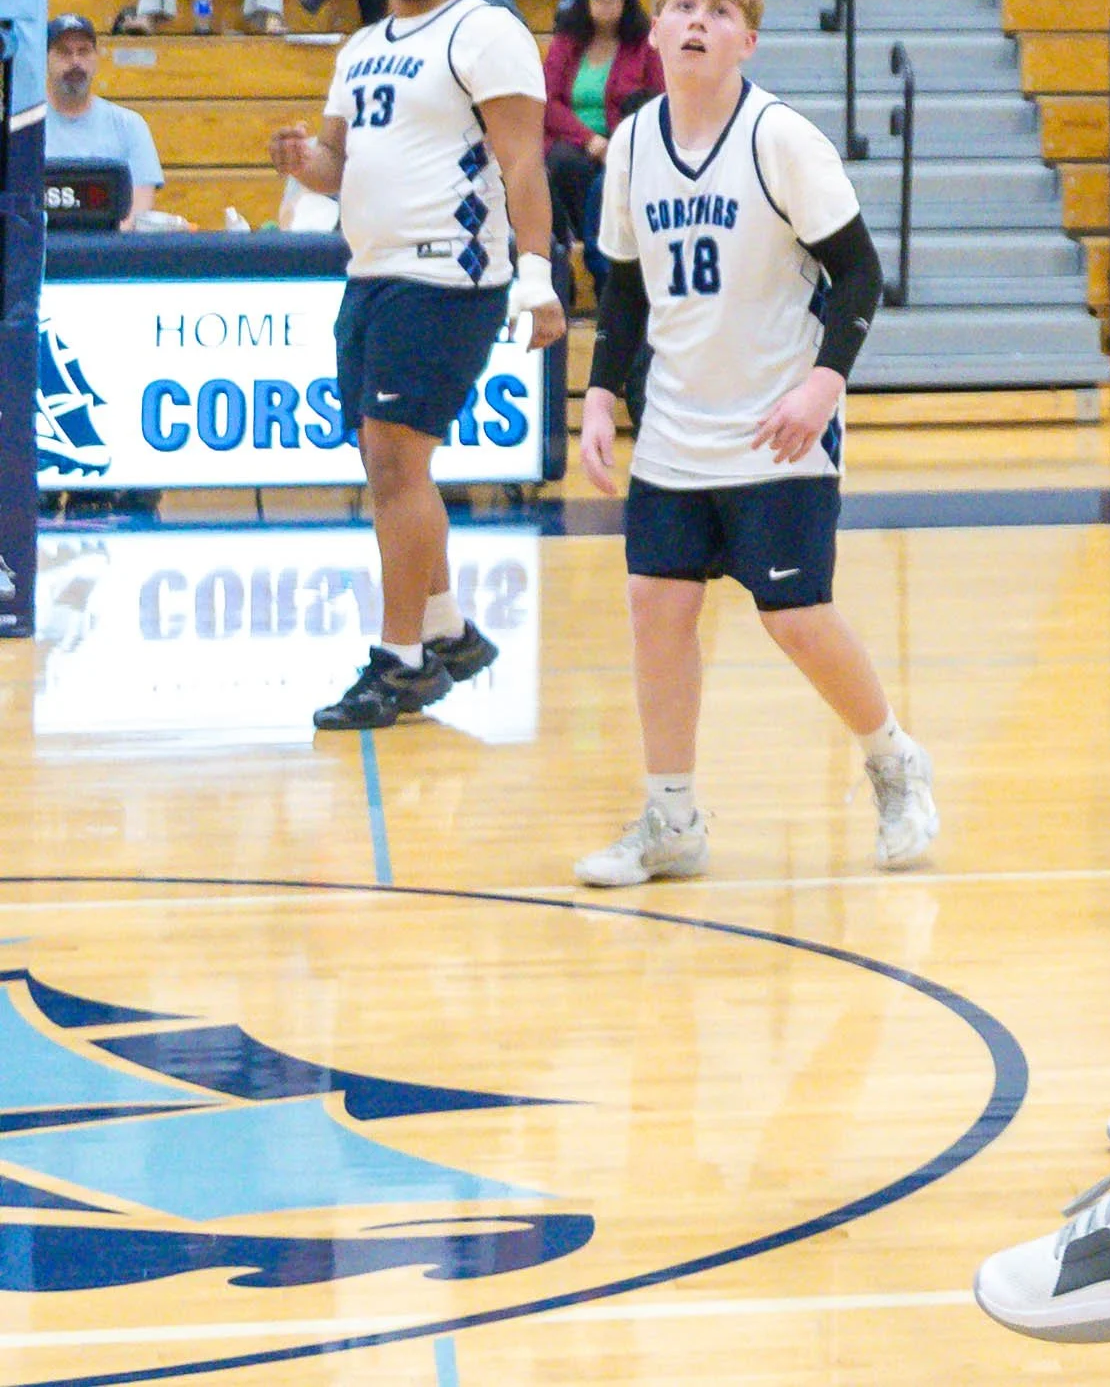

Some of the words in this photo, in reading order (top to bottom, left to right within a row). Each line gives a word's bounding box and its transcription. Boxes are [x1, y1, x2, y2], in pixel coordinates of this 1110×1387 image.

[351, 84, 396, 128] 13
[667, 236, 721, 296] 18
[156, 313, 306, 348] HOME
[141, 374, 530, 453] CORSS
